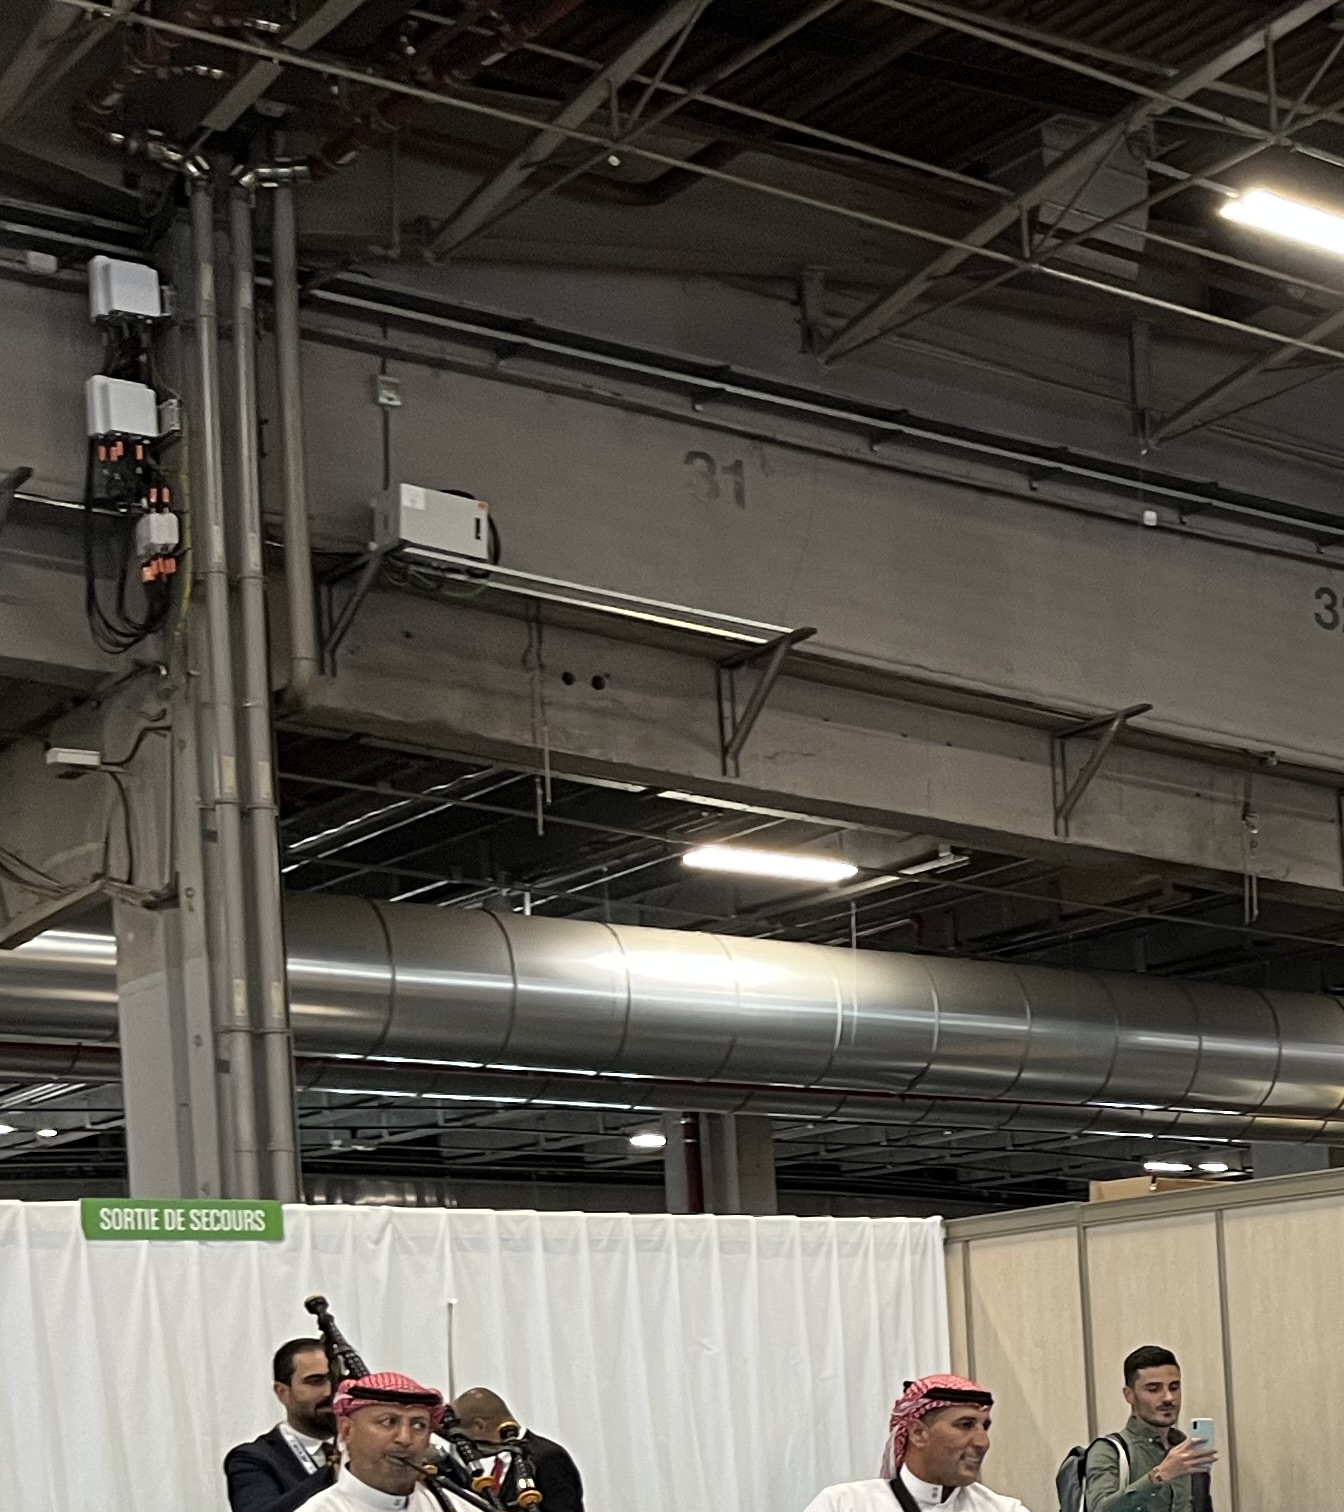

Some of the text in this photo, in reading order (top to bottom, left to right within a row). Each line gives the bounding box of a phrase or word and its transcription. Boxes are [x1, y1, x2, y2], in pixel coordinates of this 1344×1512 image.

[683, 450, 746, 510] 31
[99, 1207, 266, 1232] SORTIE DE SECOURS
